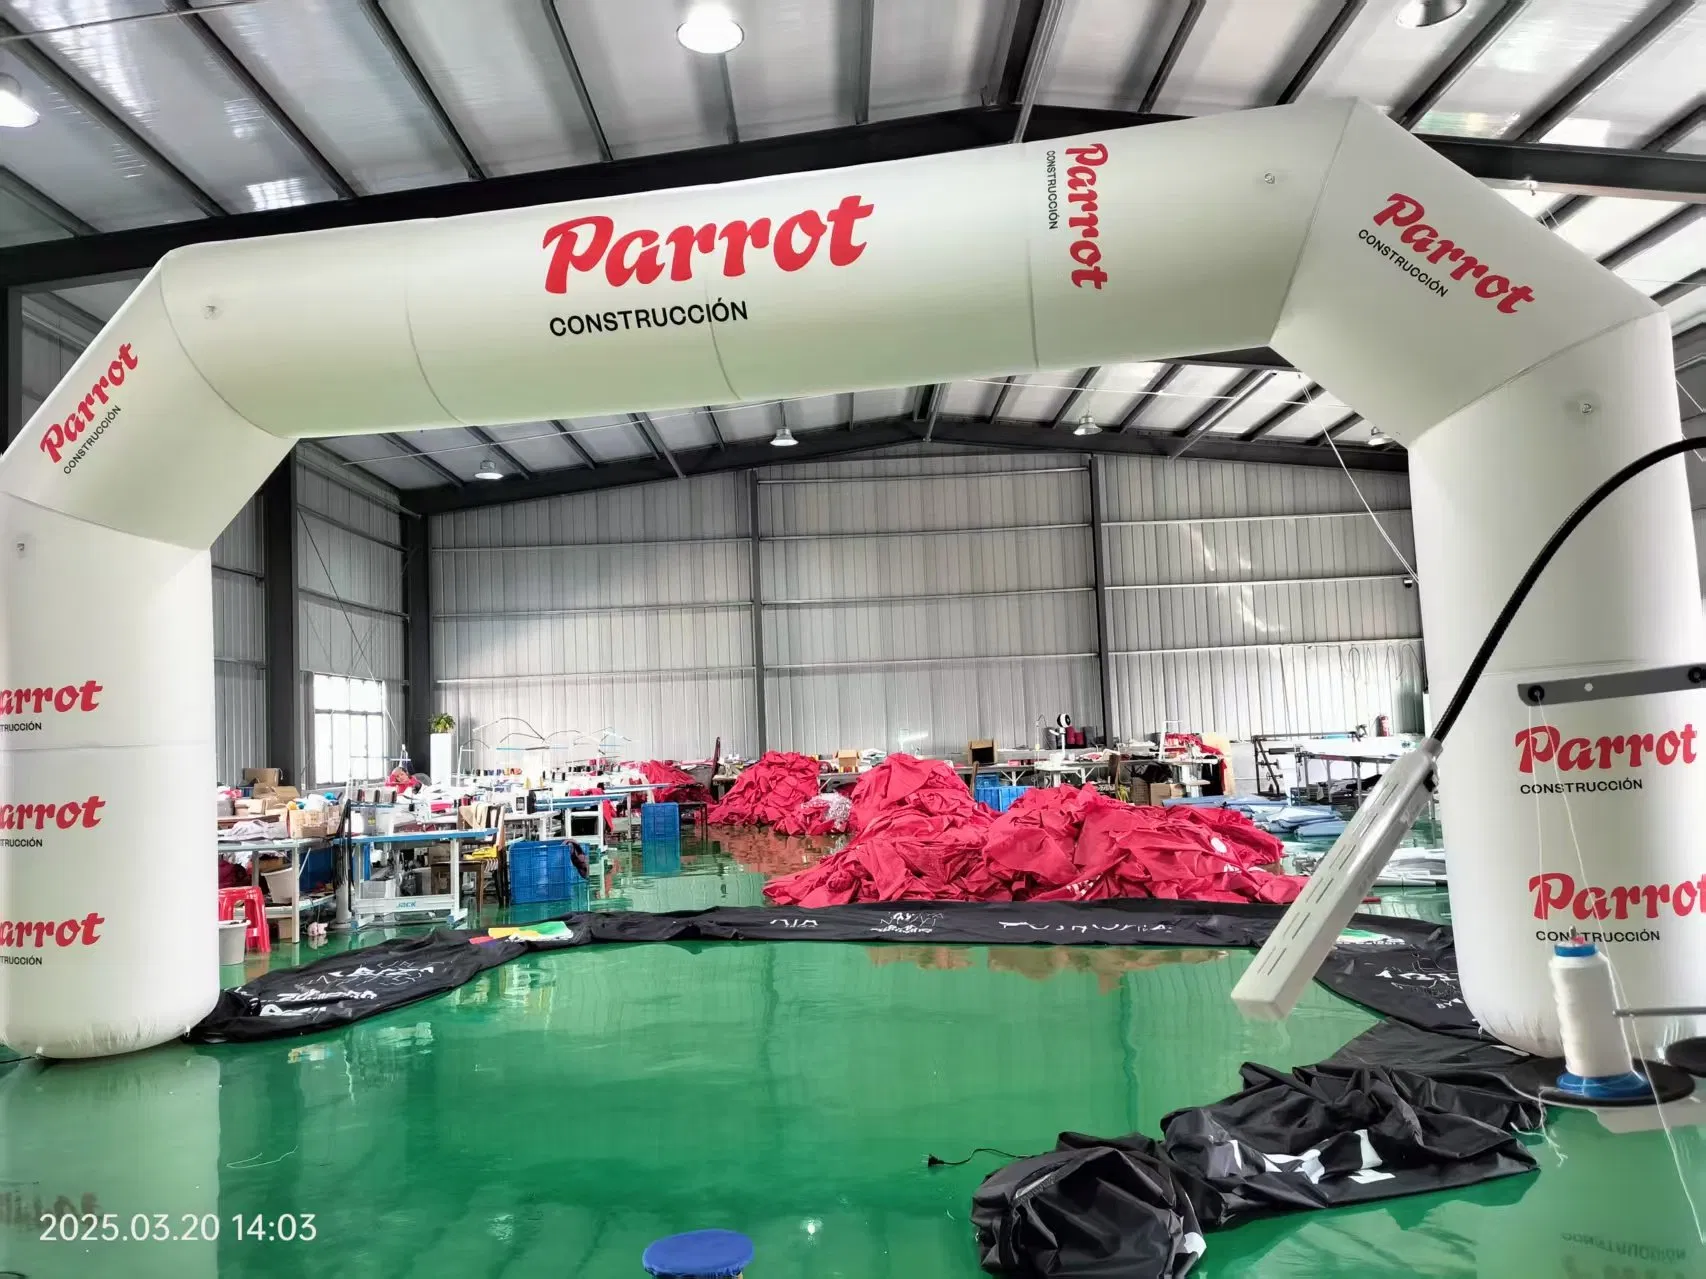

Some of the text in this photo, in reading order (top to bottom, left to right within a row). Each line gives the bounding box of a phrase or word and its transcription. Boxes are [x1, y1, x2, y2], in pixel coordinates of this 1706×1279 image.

[1046, 150, 1059, 230] CONSTRUCCIÓN
[1065, 143, 1109, 289] Parrot
[542, 195, 875, 295] Parrot
[1358, 229, 1449, 298] CONSTRUCCIÓN
[1373, 192, 1535, 314] Parrot
[549, 297, 748, 337] CONSTRUCCIÓN
[39, 343, 139, 463] Parrot
[63, 405, 121, 475] CONSTRUCCIÓN
[0, 680, 103, 716] arrot
[0, 721, 42, 732] TRUCCIÓN
[1514, 723, 1698, 774] Parrot
[1520, 777, 1643, 795] CONSTRUCCIÓN
[0, 796, 106, 830] arrot
[0, 837, 43, 848] TRUCCIÓN
[0, 912, 105, 948] arrot
[1535, 928, 1661, 943] CONTRUCCIÓN
[0, 955, 43, 966] TRUCCIÓN
